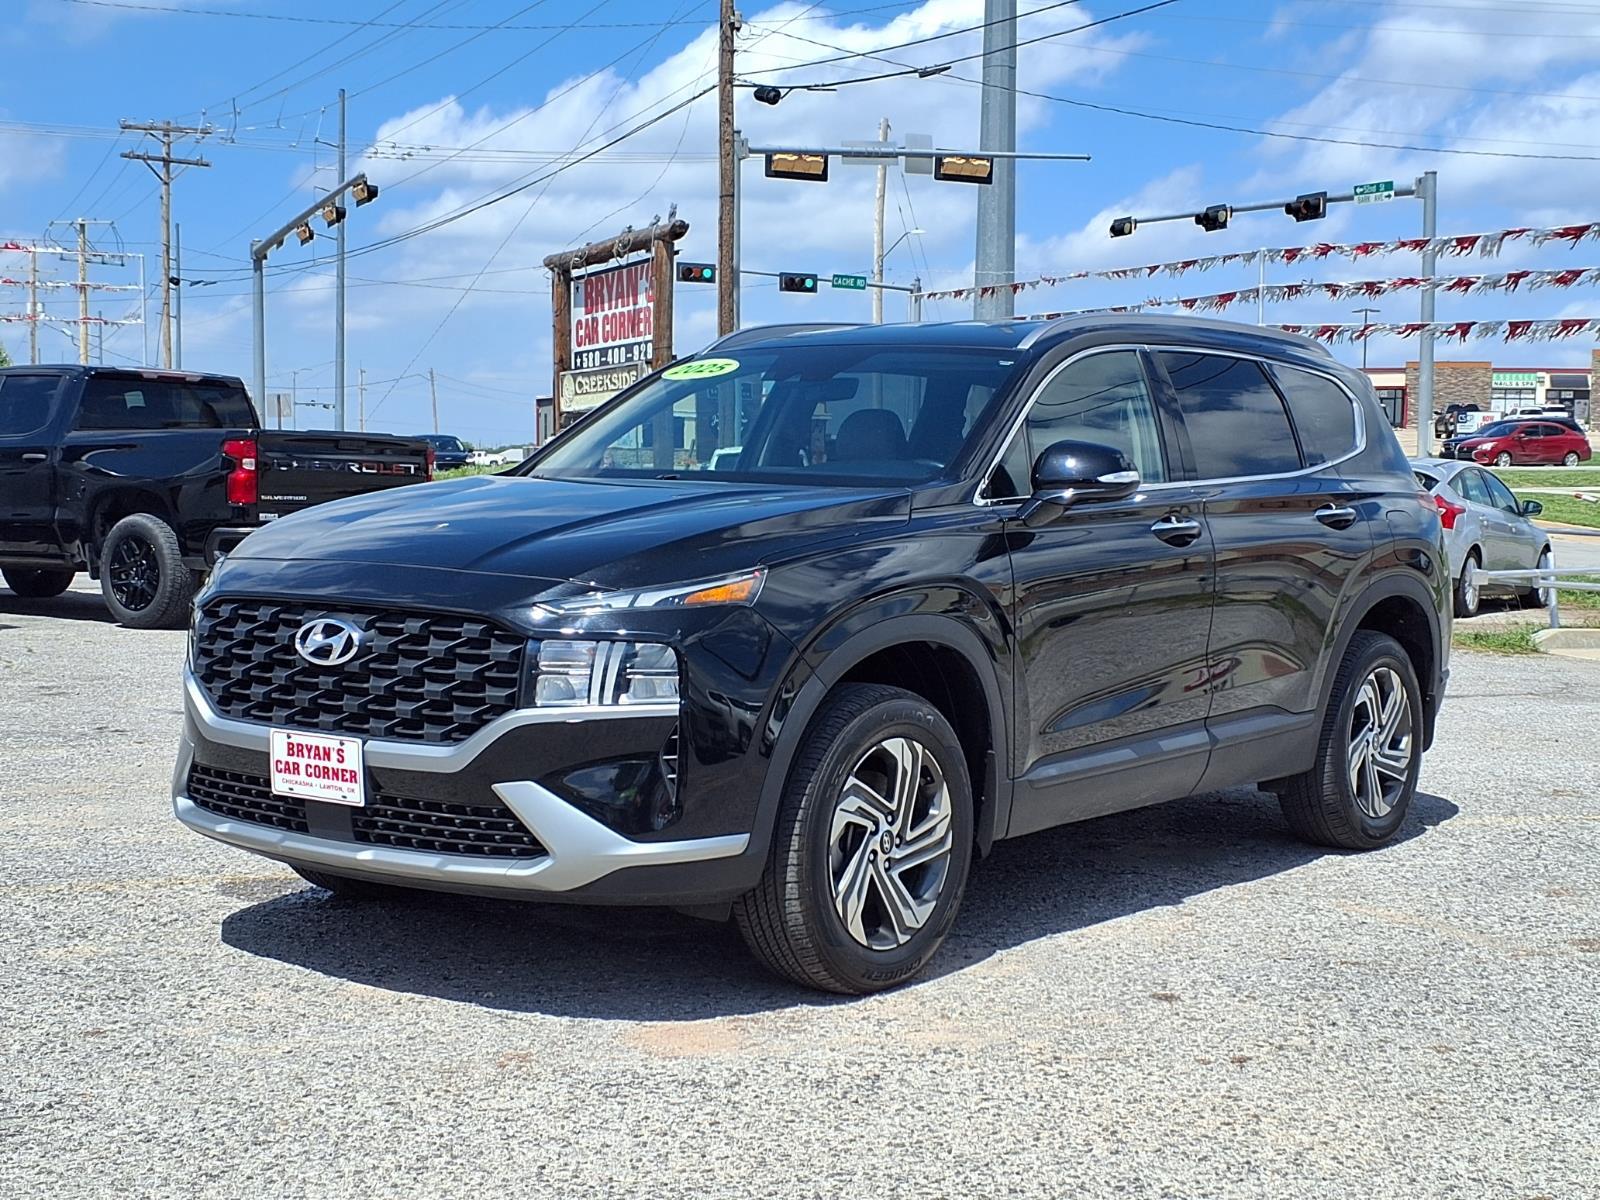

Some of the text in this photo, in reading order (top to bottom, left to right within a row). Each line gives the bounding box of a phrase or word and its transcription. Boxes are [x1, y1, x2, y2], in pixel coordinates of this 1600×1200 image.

[584, 261, 656, 315] BRYAN'S
[833, 277, 865, 287] CACHE RD
[575, 306, 654, 348] CAR CORNER
[575, 371, 638, 394] CREEKSIDE
[273, 459, 420, 475] CHEVROLET
[287, 741, 345, 764] BRYAN'S
[275, 759, 358, 784] CAR CORNER
[282, 777, 314, 788] CHICKASHA
